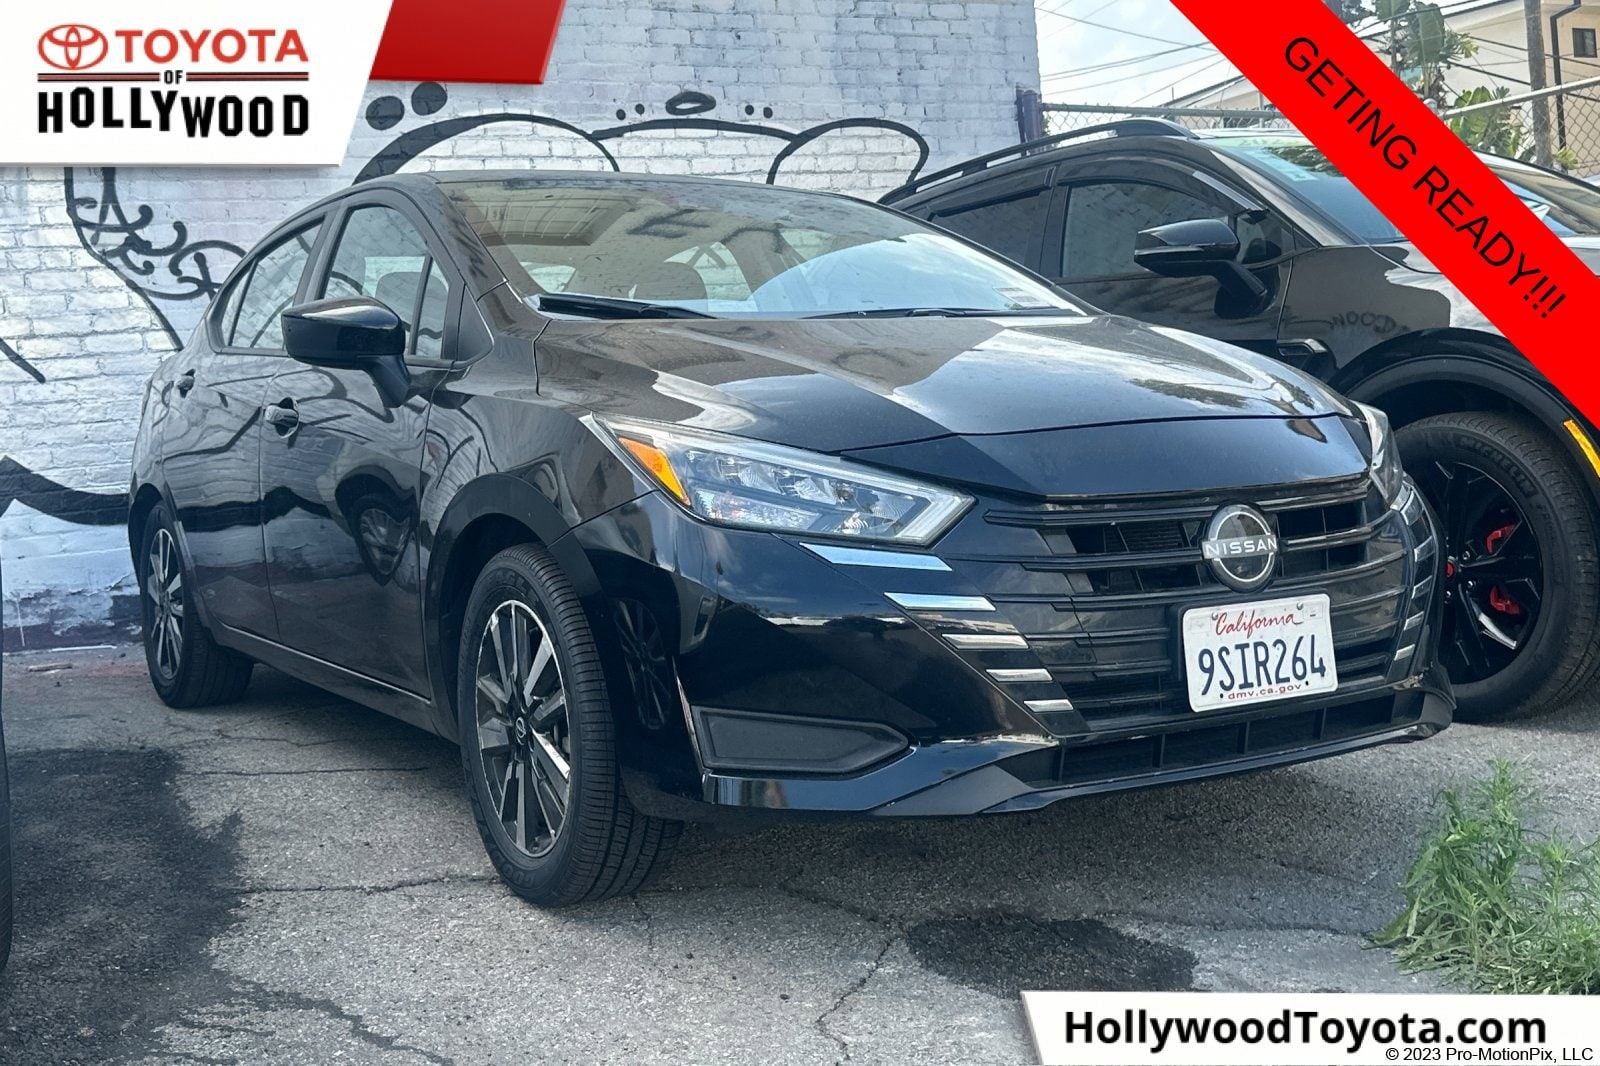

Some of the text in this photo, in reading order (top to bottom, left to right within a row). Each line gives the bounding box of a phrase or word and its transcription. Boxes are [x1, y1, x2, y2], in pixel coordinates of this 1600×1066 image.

[1204, 537, 1278, 557] NISSAN
[1215, 610, 1304, 639] California
[1198, 634, 1327, 696] 9SIR264
[1228, 683, 1302, 700] dmv.ca.gov
